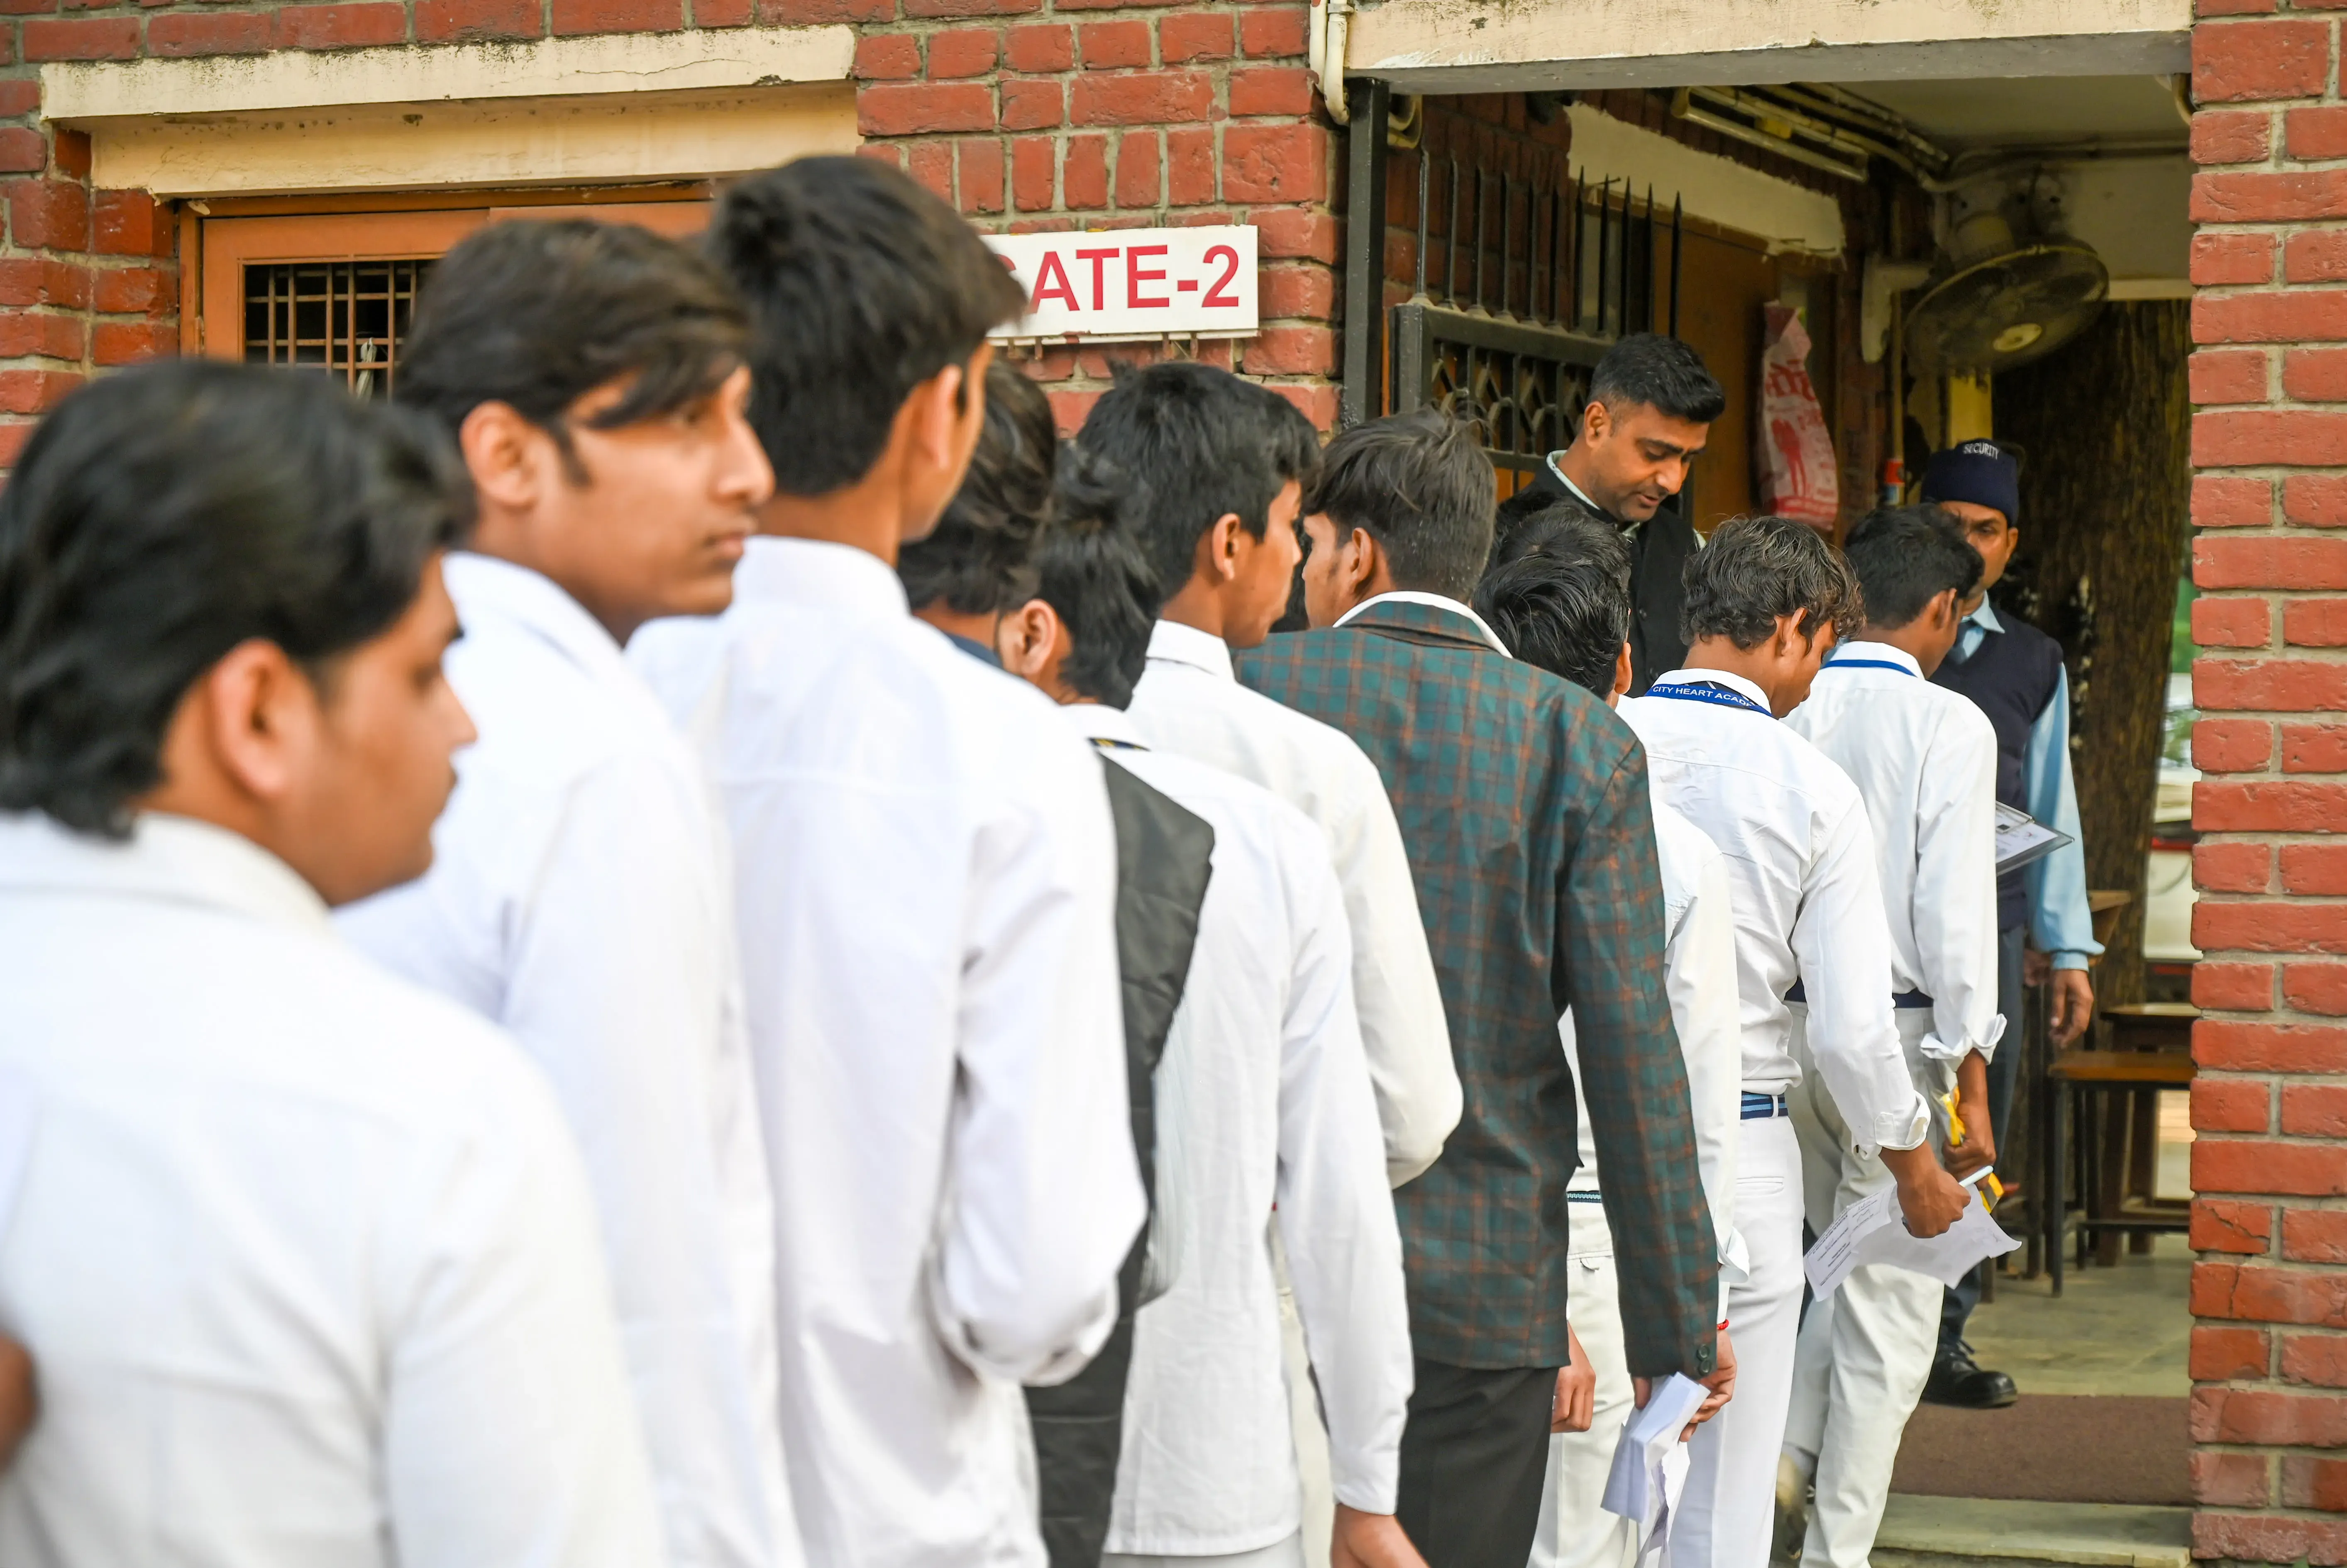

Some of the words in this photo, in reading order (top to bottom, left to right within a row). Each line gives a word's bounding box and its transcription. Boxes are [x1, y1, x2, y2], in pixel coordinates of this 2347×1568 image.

[997, 244, 1239, 314] ATE-2
[1964, 442, 1999, 460] SECURITY
[1675, 687, 1713, 697] HEART
